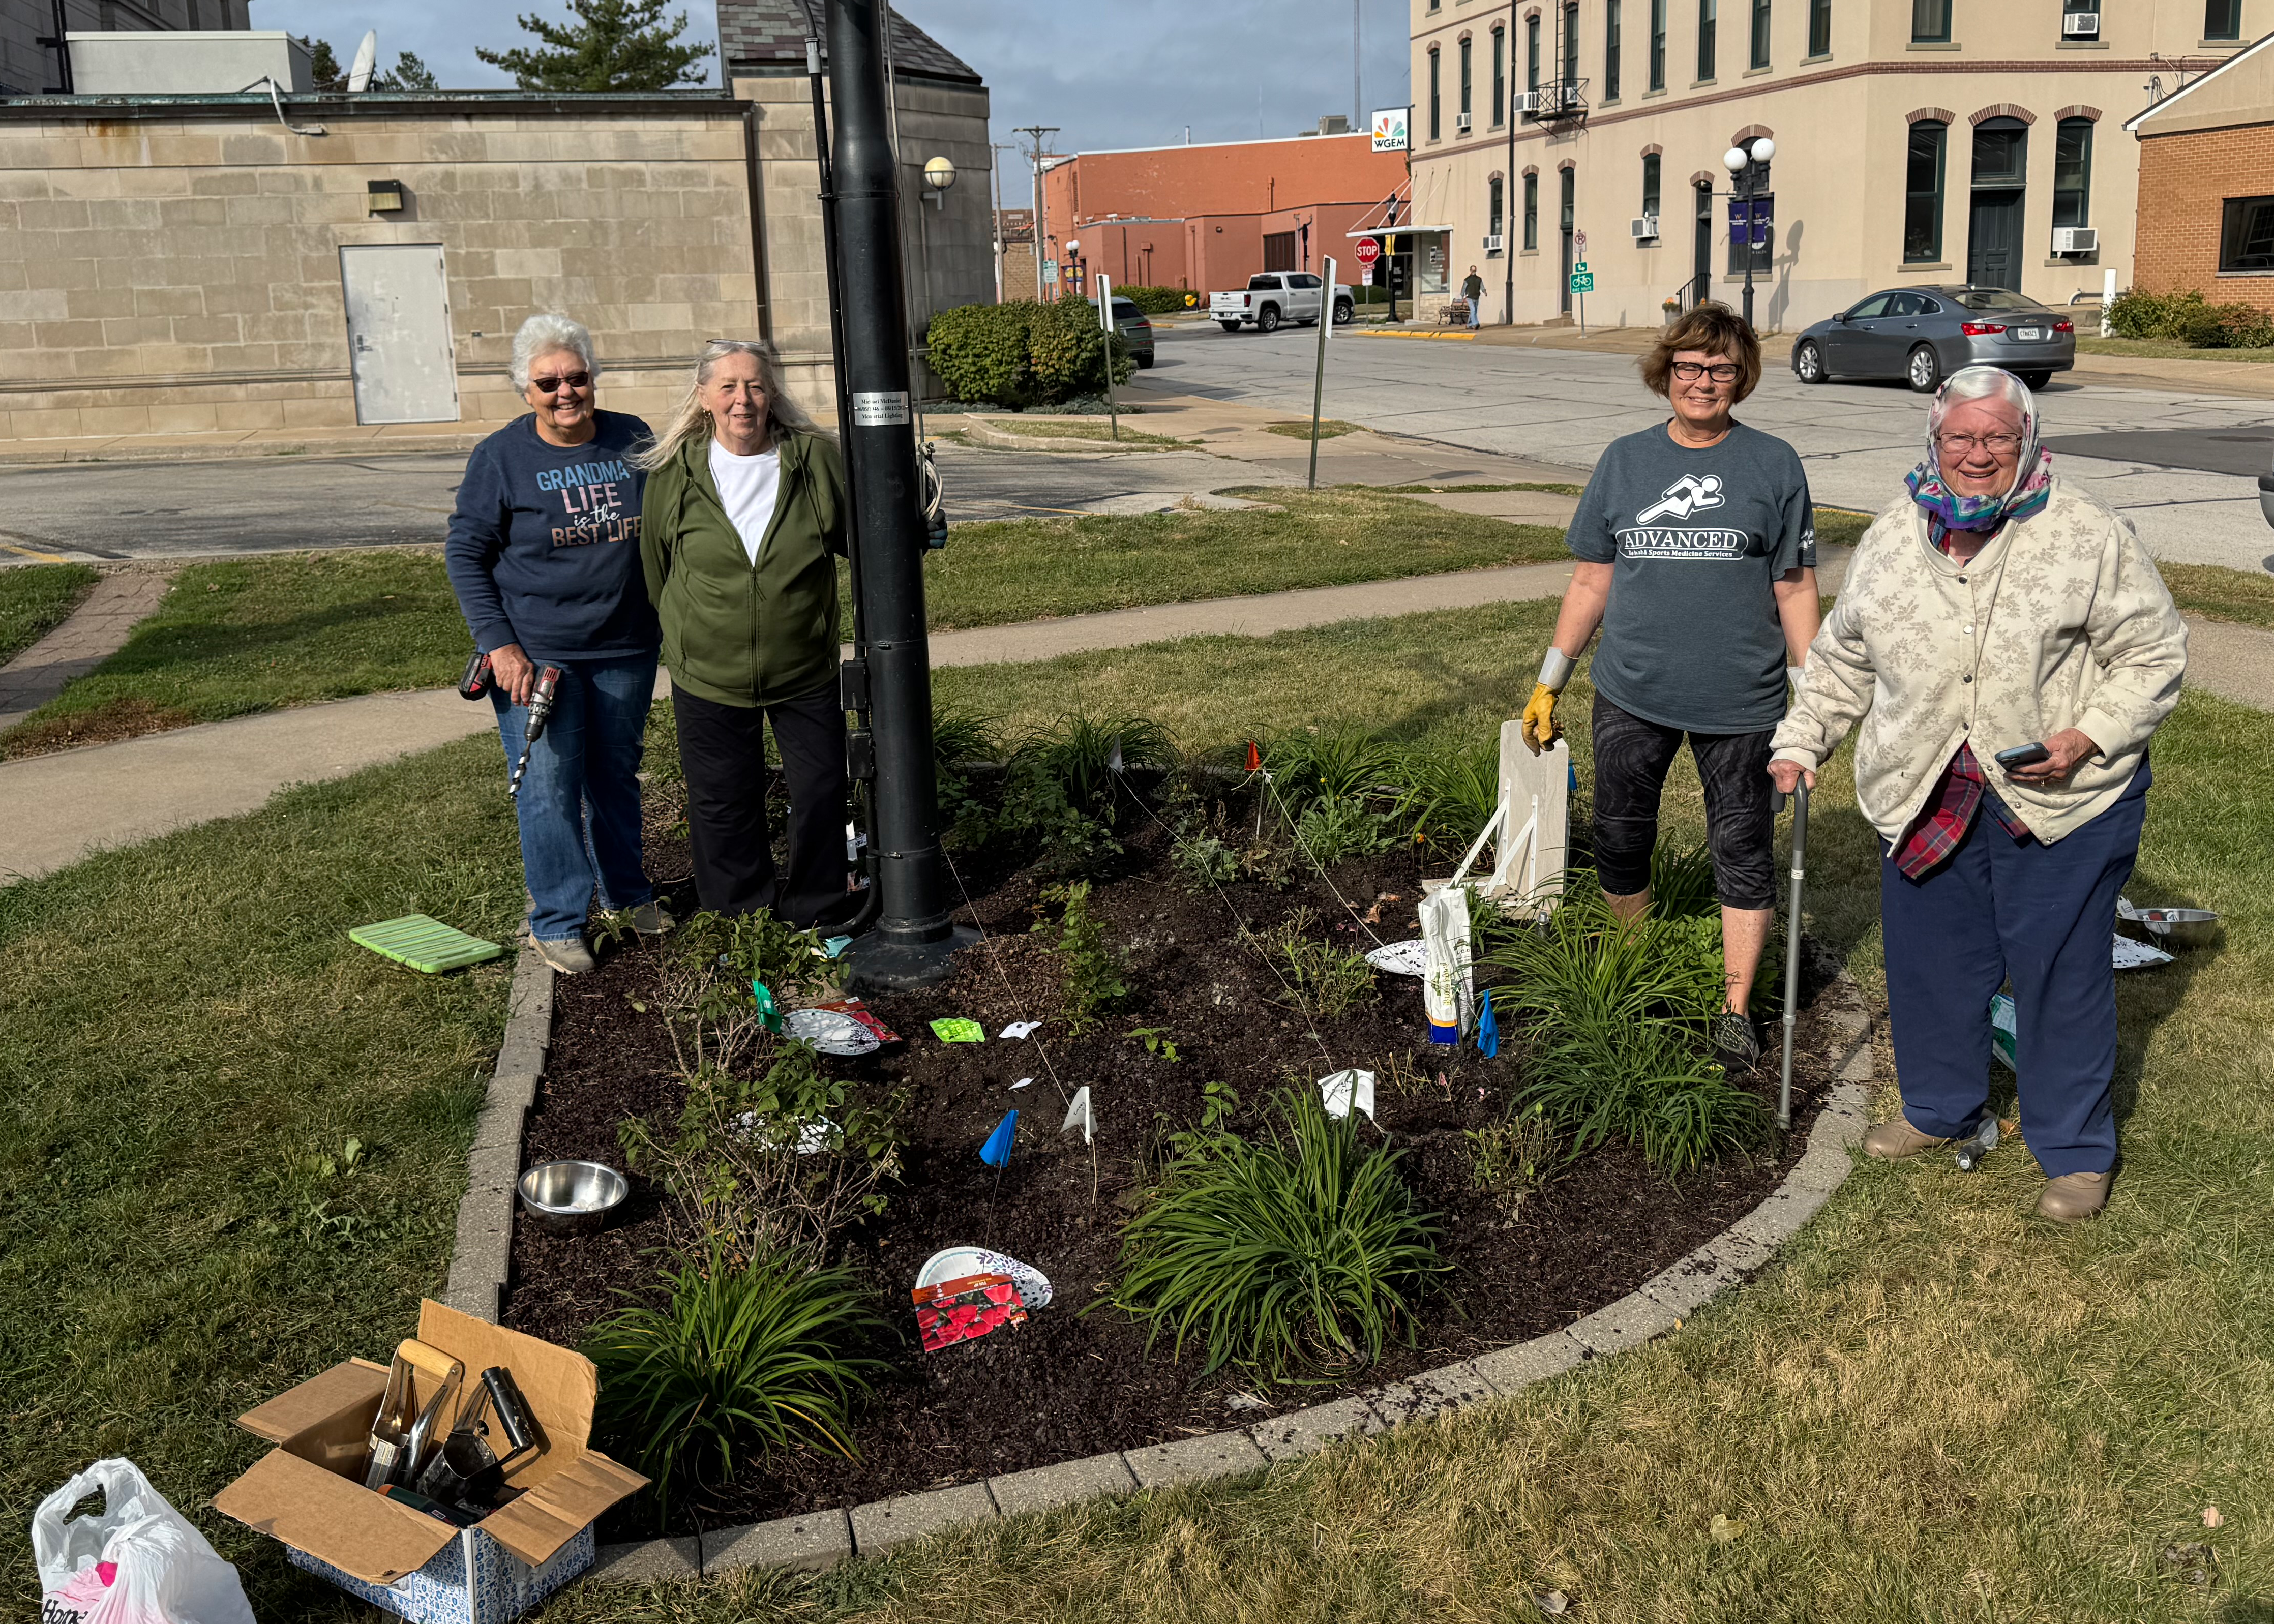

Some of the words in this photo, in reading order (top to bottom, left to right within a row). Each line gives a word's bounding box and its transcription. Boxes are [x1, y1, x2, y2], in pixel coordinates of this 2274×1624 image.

[1374, 138, 1405, 147] WGEM
[1357, 246, 1378, 256] STOP
[536, 460, 630, 491] GRANDMA
[561, 483, 622, 513] LIFE
[574, 515, 591, 528] is
[590, 503, 620, 523] the
[552, 523, 600, 547] BEST
[607, 515, 641, 542] LIFE
[1625, 531, 1738, 548] ADVANCED
